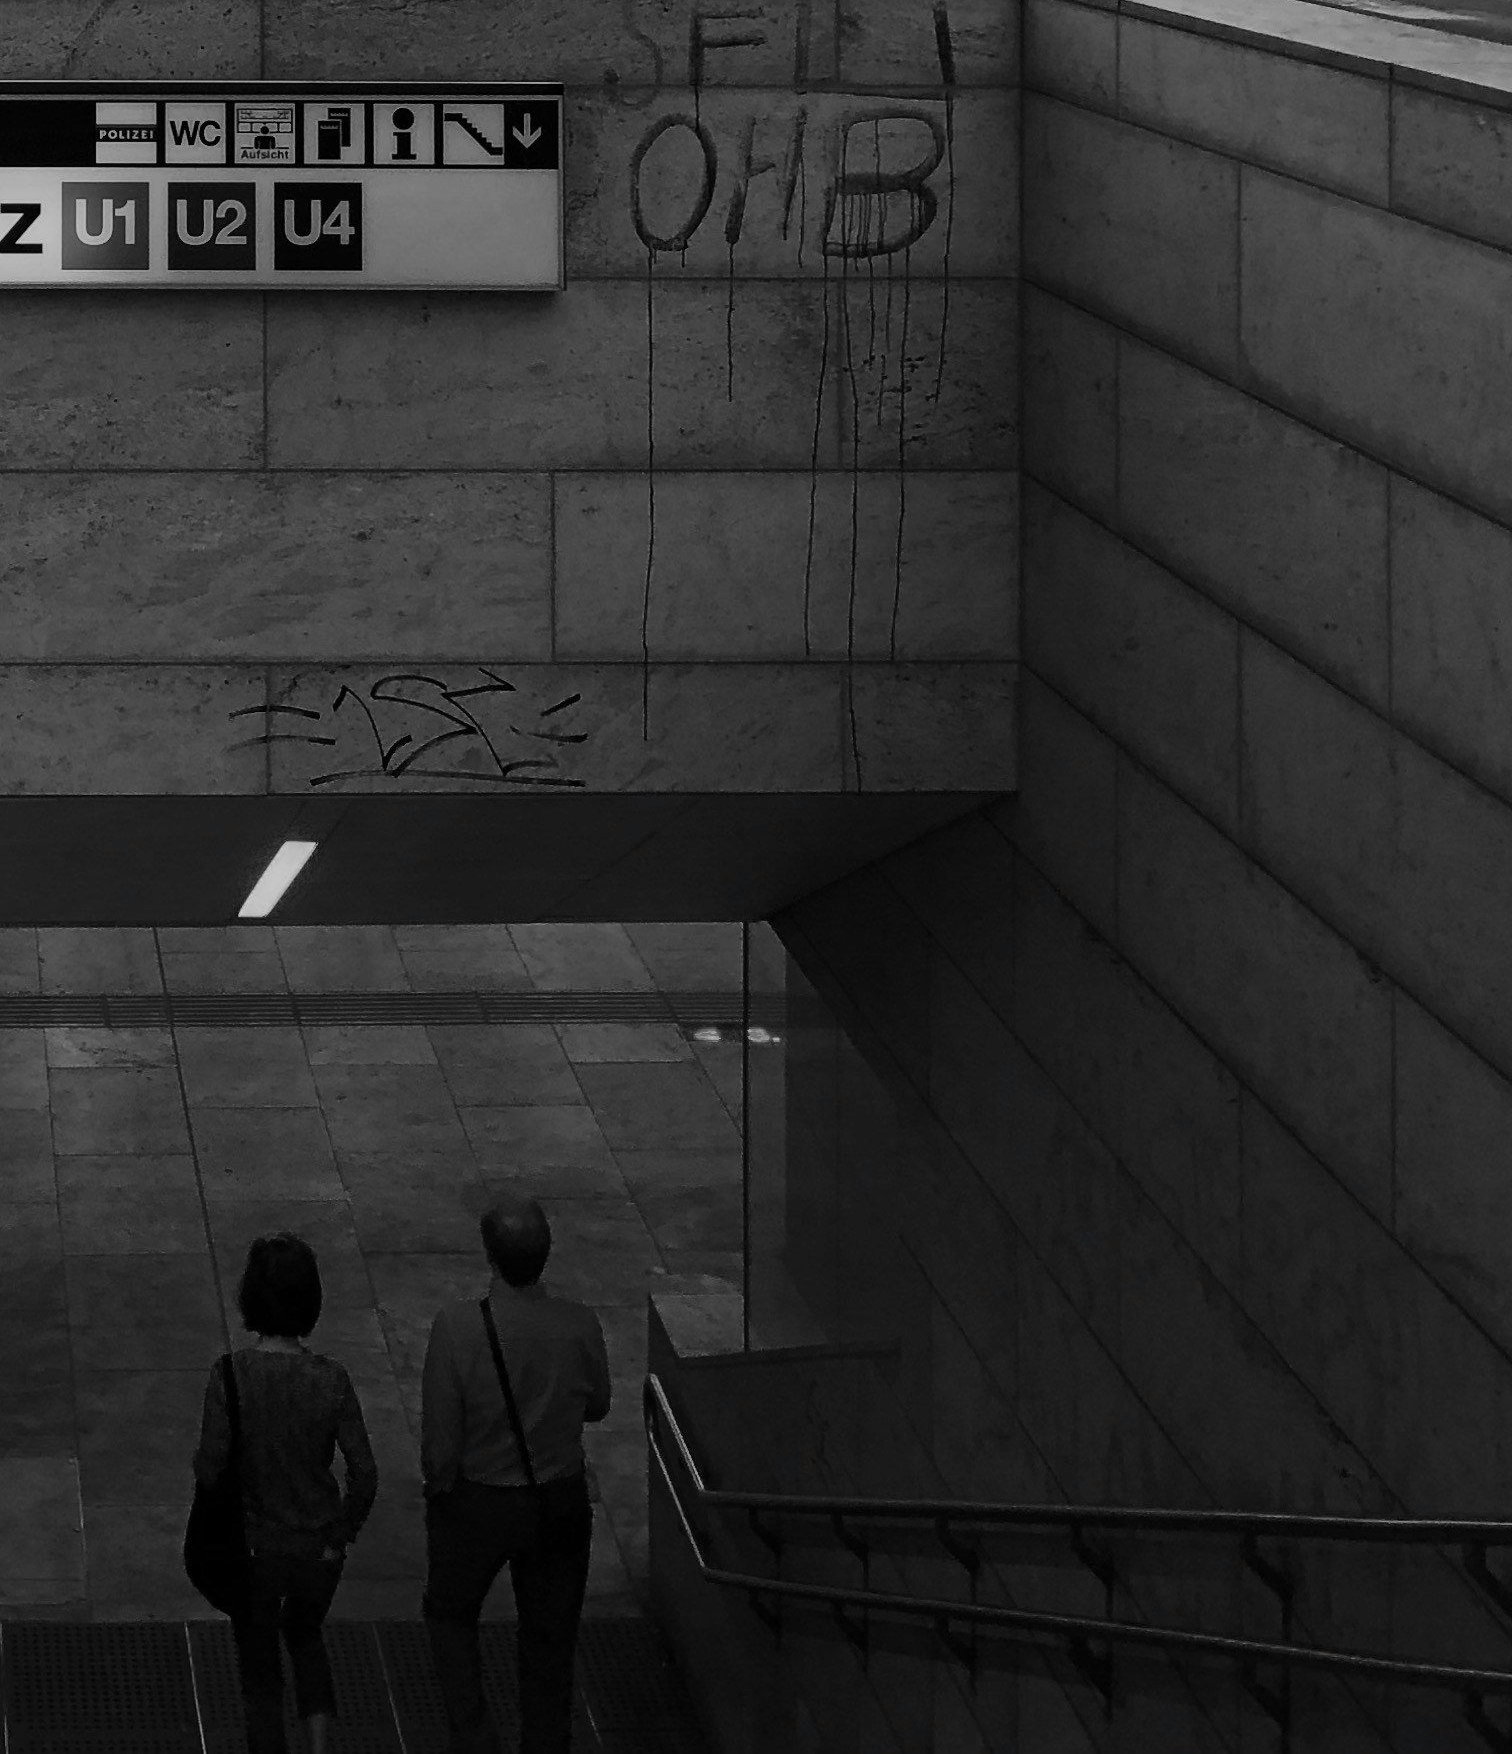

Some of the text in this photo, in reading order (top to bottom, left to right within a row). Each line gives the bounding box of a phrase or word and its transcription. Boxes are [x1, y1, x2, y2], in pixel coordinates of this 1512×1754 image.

[99, 129, 155, 140] POLIZEI
[169, 120, 222, 147] WC
[240, 149, 289, 160] Aufsicht
[75, 198, 136, 246] U1
[176, 198, 248, 246] U2
[284, 198, 355, 246] U4
